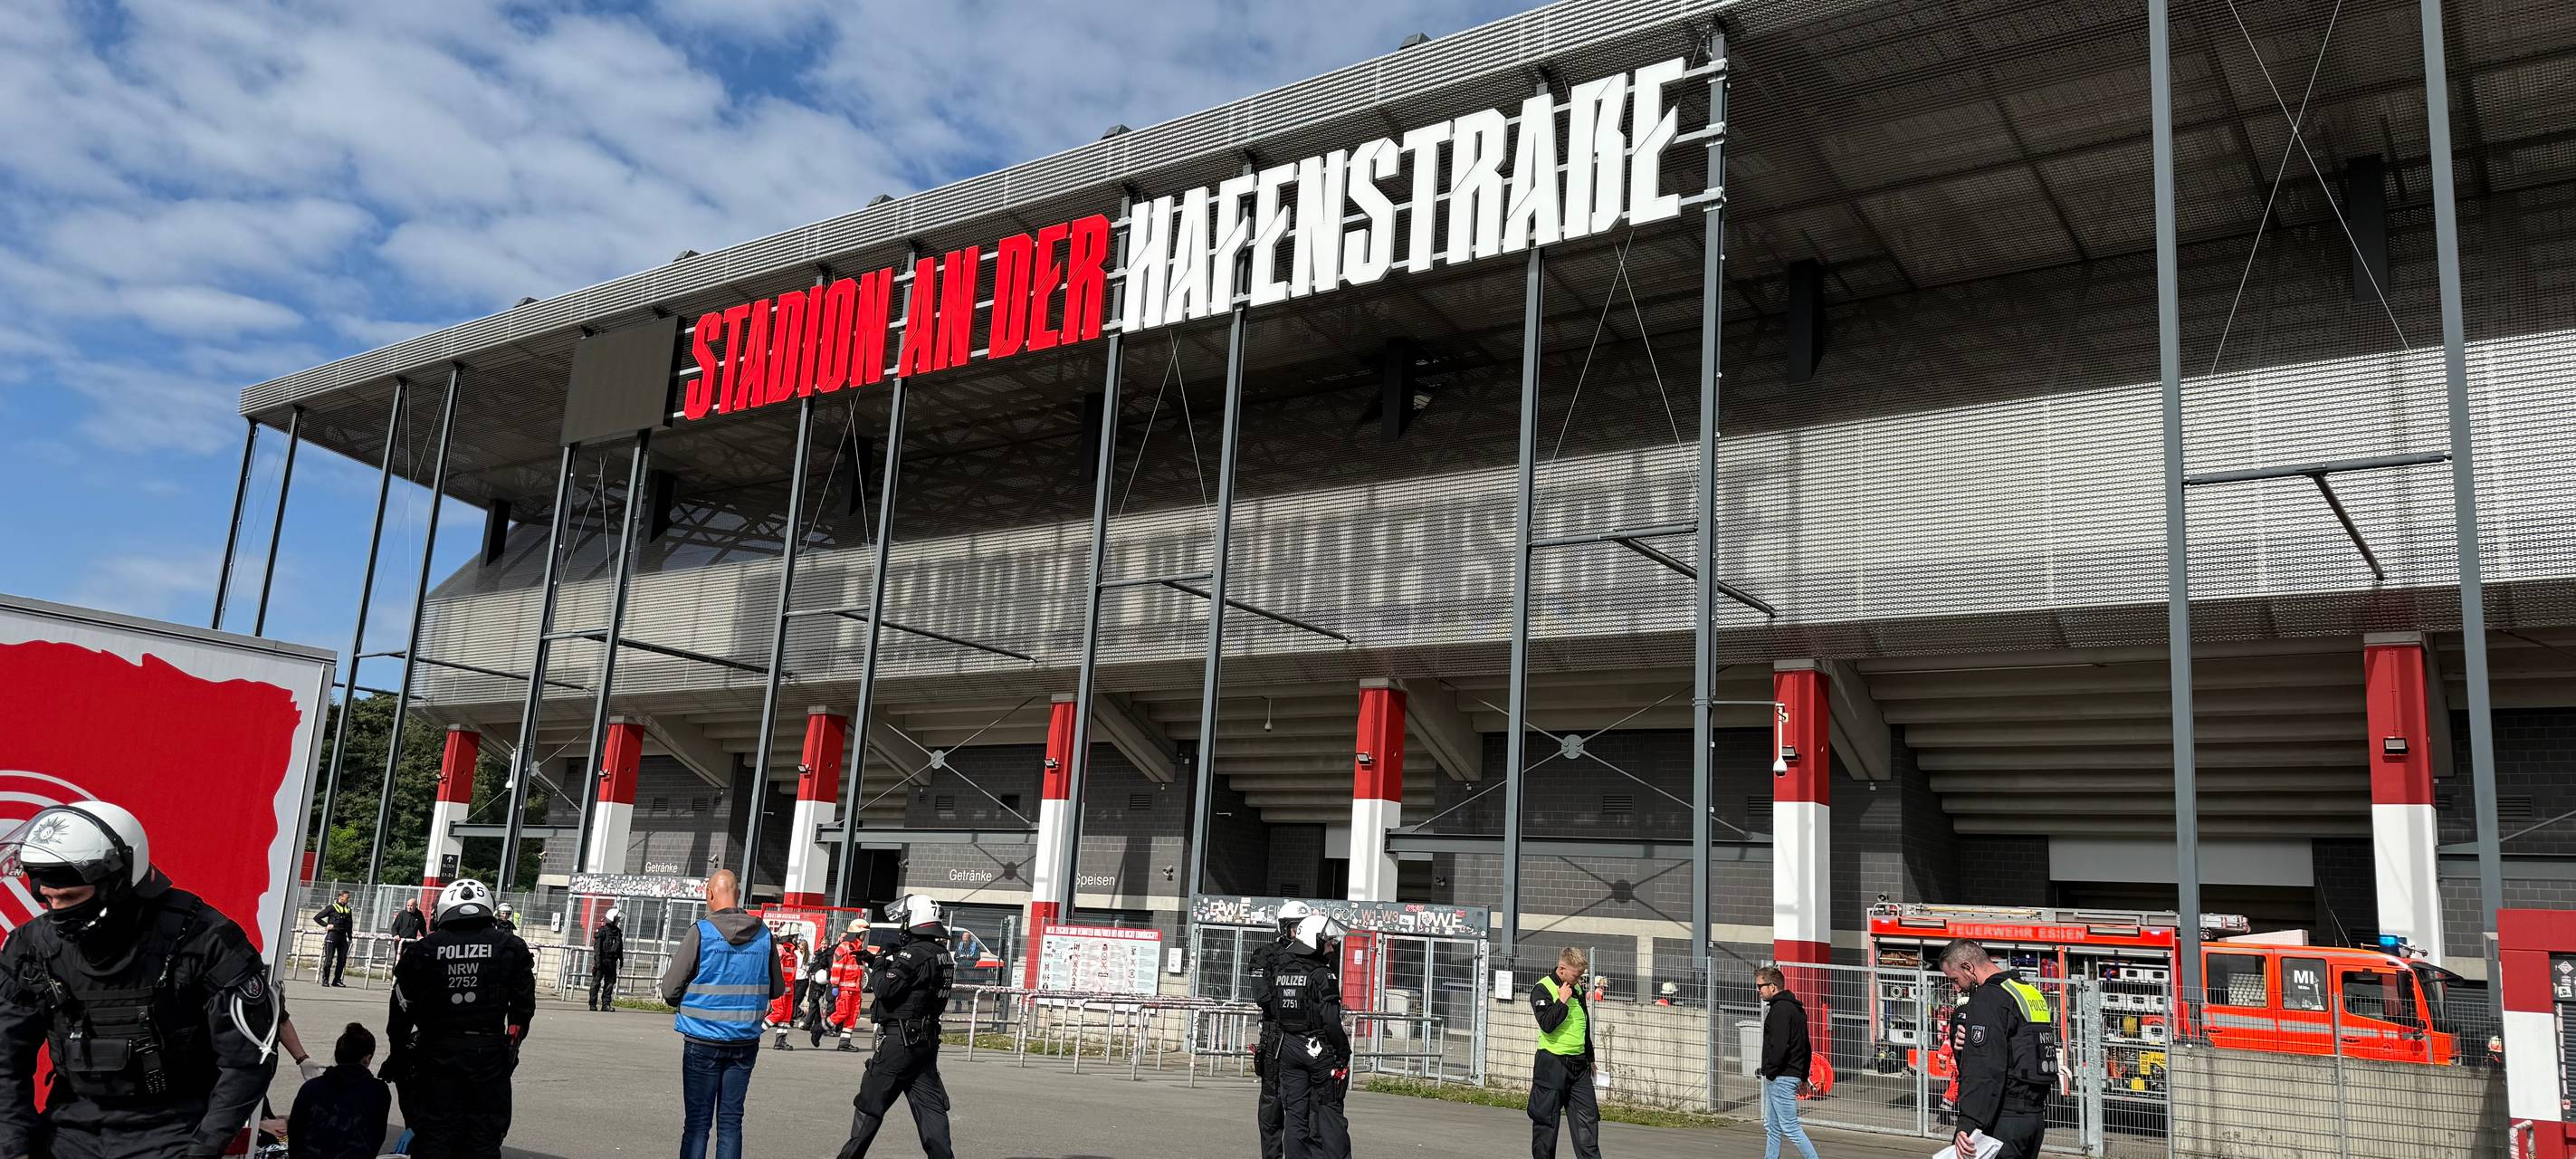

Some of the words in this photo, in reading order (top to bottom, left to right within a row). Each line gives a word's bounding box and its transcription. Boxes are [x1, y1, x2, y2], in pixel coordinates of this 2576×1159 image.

[684, 267, 893, 421] STADION
[898, 245, 981, 378] AN
[987, 214, 1111, 359] DER
[645, 861, 678, 874] Getränke
[949, 868, 992, 882] Getränke
[1076, 873, 1115, 887] Speisen
[449, 889, 457, 901] 7
[476, 886, 485, 897] 5
[931, 906, 937, 916] 7
[1948, 924, 2034, 938] FEUERWEHR
[2038, 927, 2085, 941] ESSEN
[436, 943, 492, 960] POLIZEI
[448, 963, 480, 975] NRW
[448, 976, 478, 989] 2752
[1275, 975, 1308, 987] POLIZEI
[2294, 970, 2314, 984] MI
[1283, 988, 1296, 998] NRW
[1282, 999, 1298, 1009] 2751
